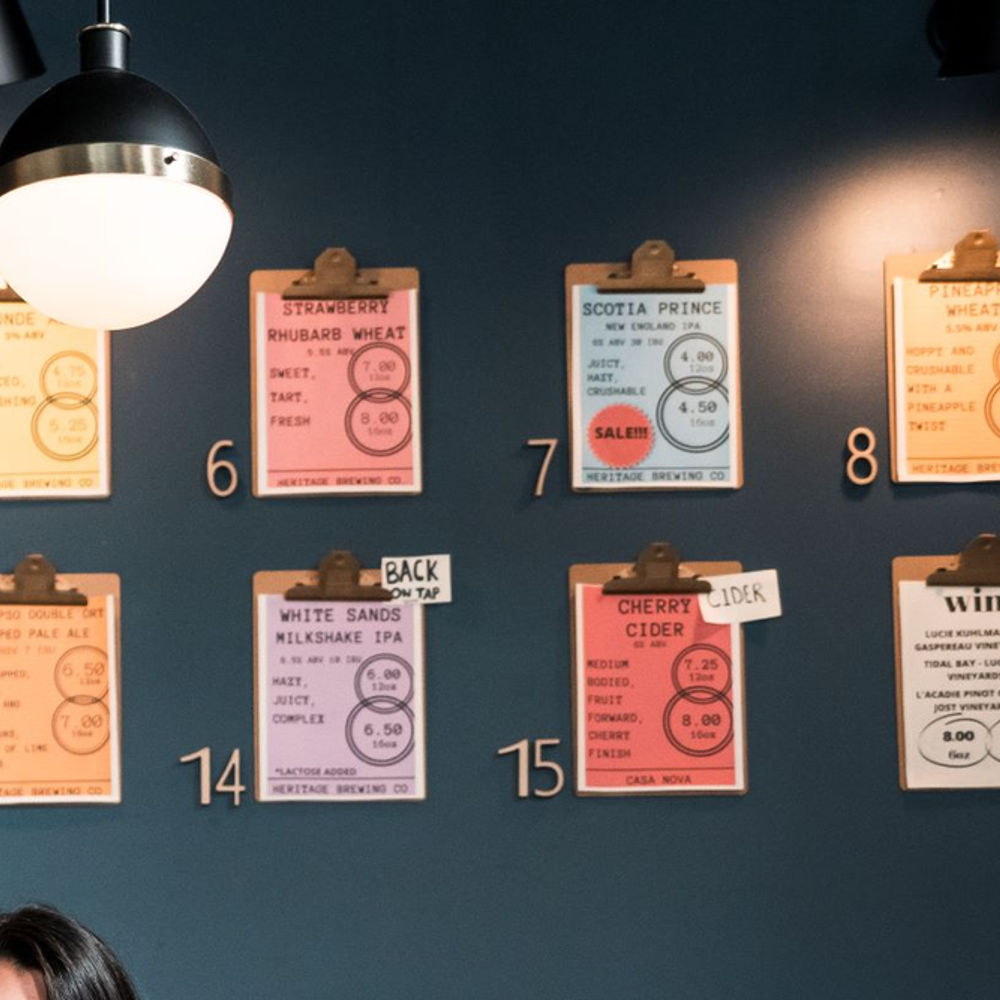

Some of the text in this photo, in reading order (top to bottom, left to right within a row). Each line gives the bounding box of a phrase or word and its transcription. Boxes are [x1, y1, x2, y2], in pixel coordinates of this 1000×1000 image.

[929, 284, 1000, 299] PINEAP
[282, 300, 389, 317] STRAWBERRY
[582, 300, 724, 316] SCOTIA PRINCE
[945, 303, 1000, 318] WHEAT
[631, 322, 676, 331] ENGLAND
[681, 321, 702, 331] IPA
[267, 325, 407, 343] RHUBARB WHEAT
[679, 351, 716, 363] 4.00
[905, 345, 975, 358] HOPPY AND
[361, 360, 397, 374] 7.00
[905, 364, 975, 376] CRUSHABLE
[586, 386, 648, 397] CRUSHABLE
[906, 383, 953, 395] WITH A
[677, 400, 718, 415] 4.50
[907, 401, 976, 413] PINEAPPLE
[269, 415, 312, 428] FRESH
[359, 410, 400, 425] 8.00
[906, 421, 947, 432] TWIST
[846, 426, 879, 486] 8
[206, 438, 239, 498] 6
[525, 437, 560, 497] 7
[911, 463, 969, 475] HERITAGE
[276, 476, 383, 487] HERITAGE BREWING
[586, 472, 726, 482] HERITAGE BREWING CO
[21, 480, 73, 491] BREWING
[384, 559, 441, 584] BACK
[415, 587, 441, 601] TAP
[707, 581, 768, 609] CIDER
[617, 598, 692, 616] CHERRY
[28, 607, 74, 620] DOUBLE
[279, 608, 402, 623] WHITE SANDS
[28, 628, 60, 639] PALE
[66, 627, 90, 639] ALE
[625, 622, 685, 638] CIDER
[925, 629, 954, 639] LUCIE
[275, 630, 403, 645] MILKSHAKE IPA
[914, 641, 973, 652] GASPEREAU
[61, 662, 106, 678] 6.50
[586, 659, 630, 670] MEDIUM
[684, 659, 719, 671] 7.25
[924, 659, 976, 669] TIDAL BAY
[365, 668, 402, 680] 6.00
[587, 695, 624, 705] FRUIT
[916, 689, 995, 700] L'ACADIE PINOT
[934, 703, 957, 714] JOST
[59, 714, 104, 730] 7.00
[271, 714, 326, 725] COMPLEX
[681, 714, 722, 727] 8.00
[363, 722, 403, 736] 6.50
[587, 730, 631, 741] CHERRY
[942, 730, 976, 743] 8.00
[587, 748, 632, 759] FINISH
[323, 767, 358, 776] ADDED
[496, 738, 566, 798] 15
[179, 744, 246, 807] 14
[625, 774, 692, 786] CASA NOVA
[30, 786, 82, 798] BREWING
[271, 783, 387, 795] HERITAGE BREWING
